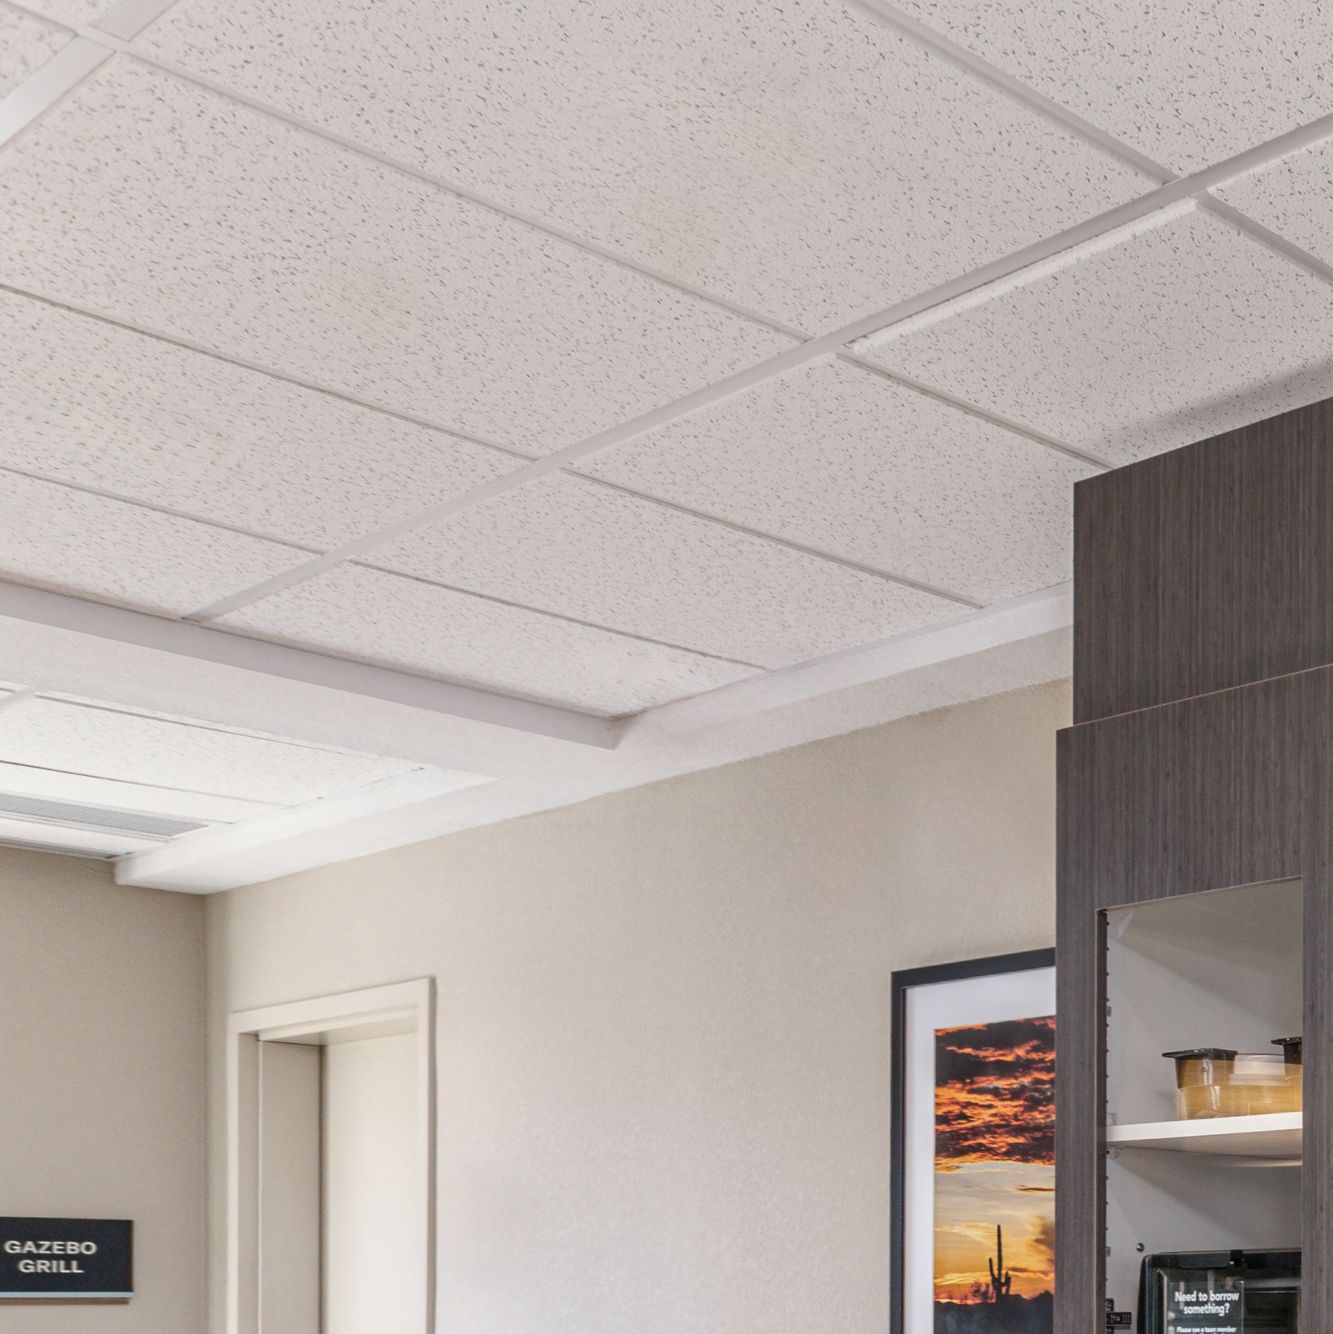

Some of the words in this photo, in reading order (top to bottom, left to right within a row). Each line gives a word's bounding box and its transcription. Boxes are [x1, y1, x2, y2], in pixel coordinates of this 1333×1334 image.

[4, 1240, 98, 1255] GAZEBO
[18, 1259, 85, 1273] GRILL
[1174, 1290, 1197, 1301] Need
[1198, 1291, 1208, 1301] to
[1209, 1290, 1240, 1301] borrow
[1183, 1302, 1230, 1316] something?
